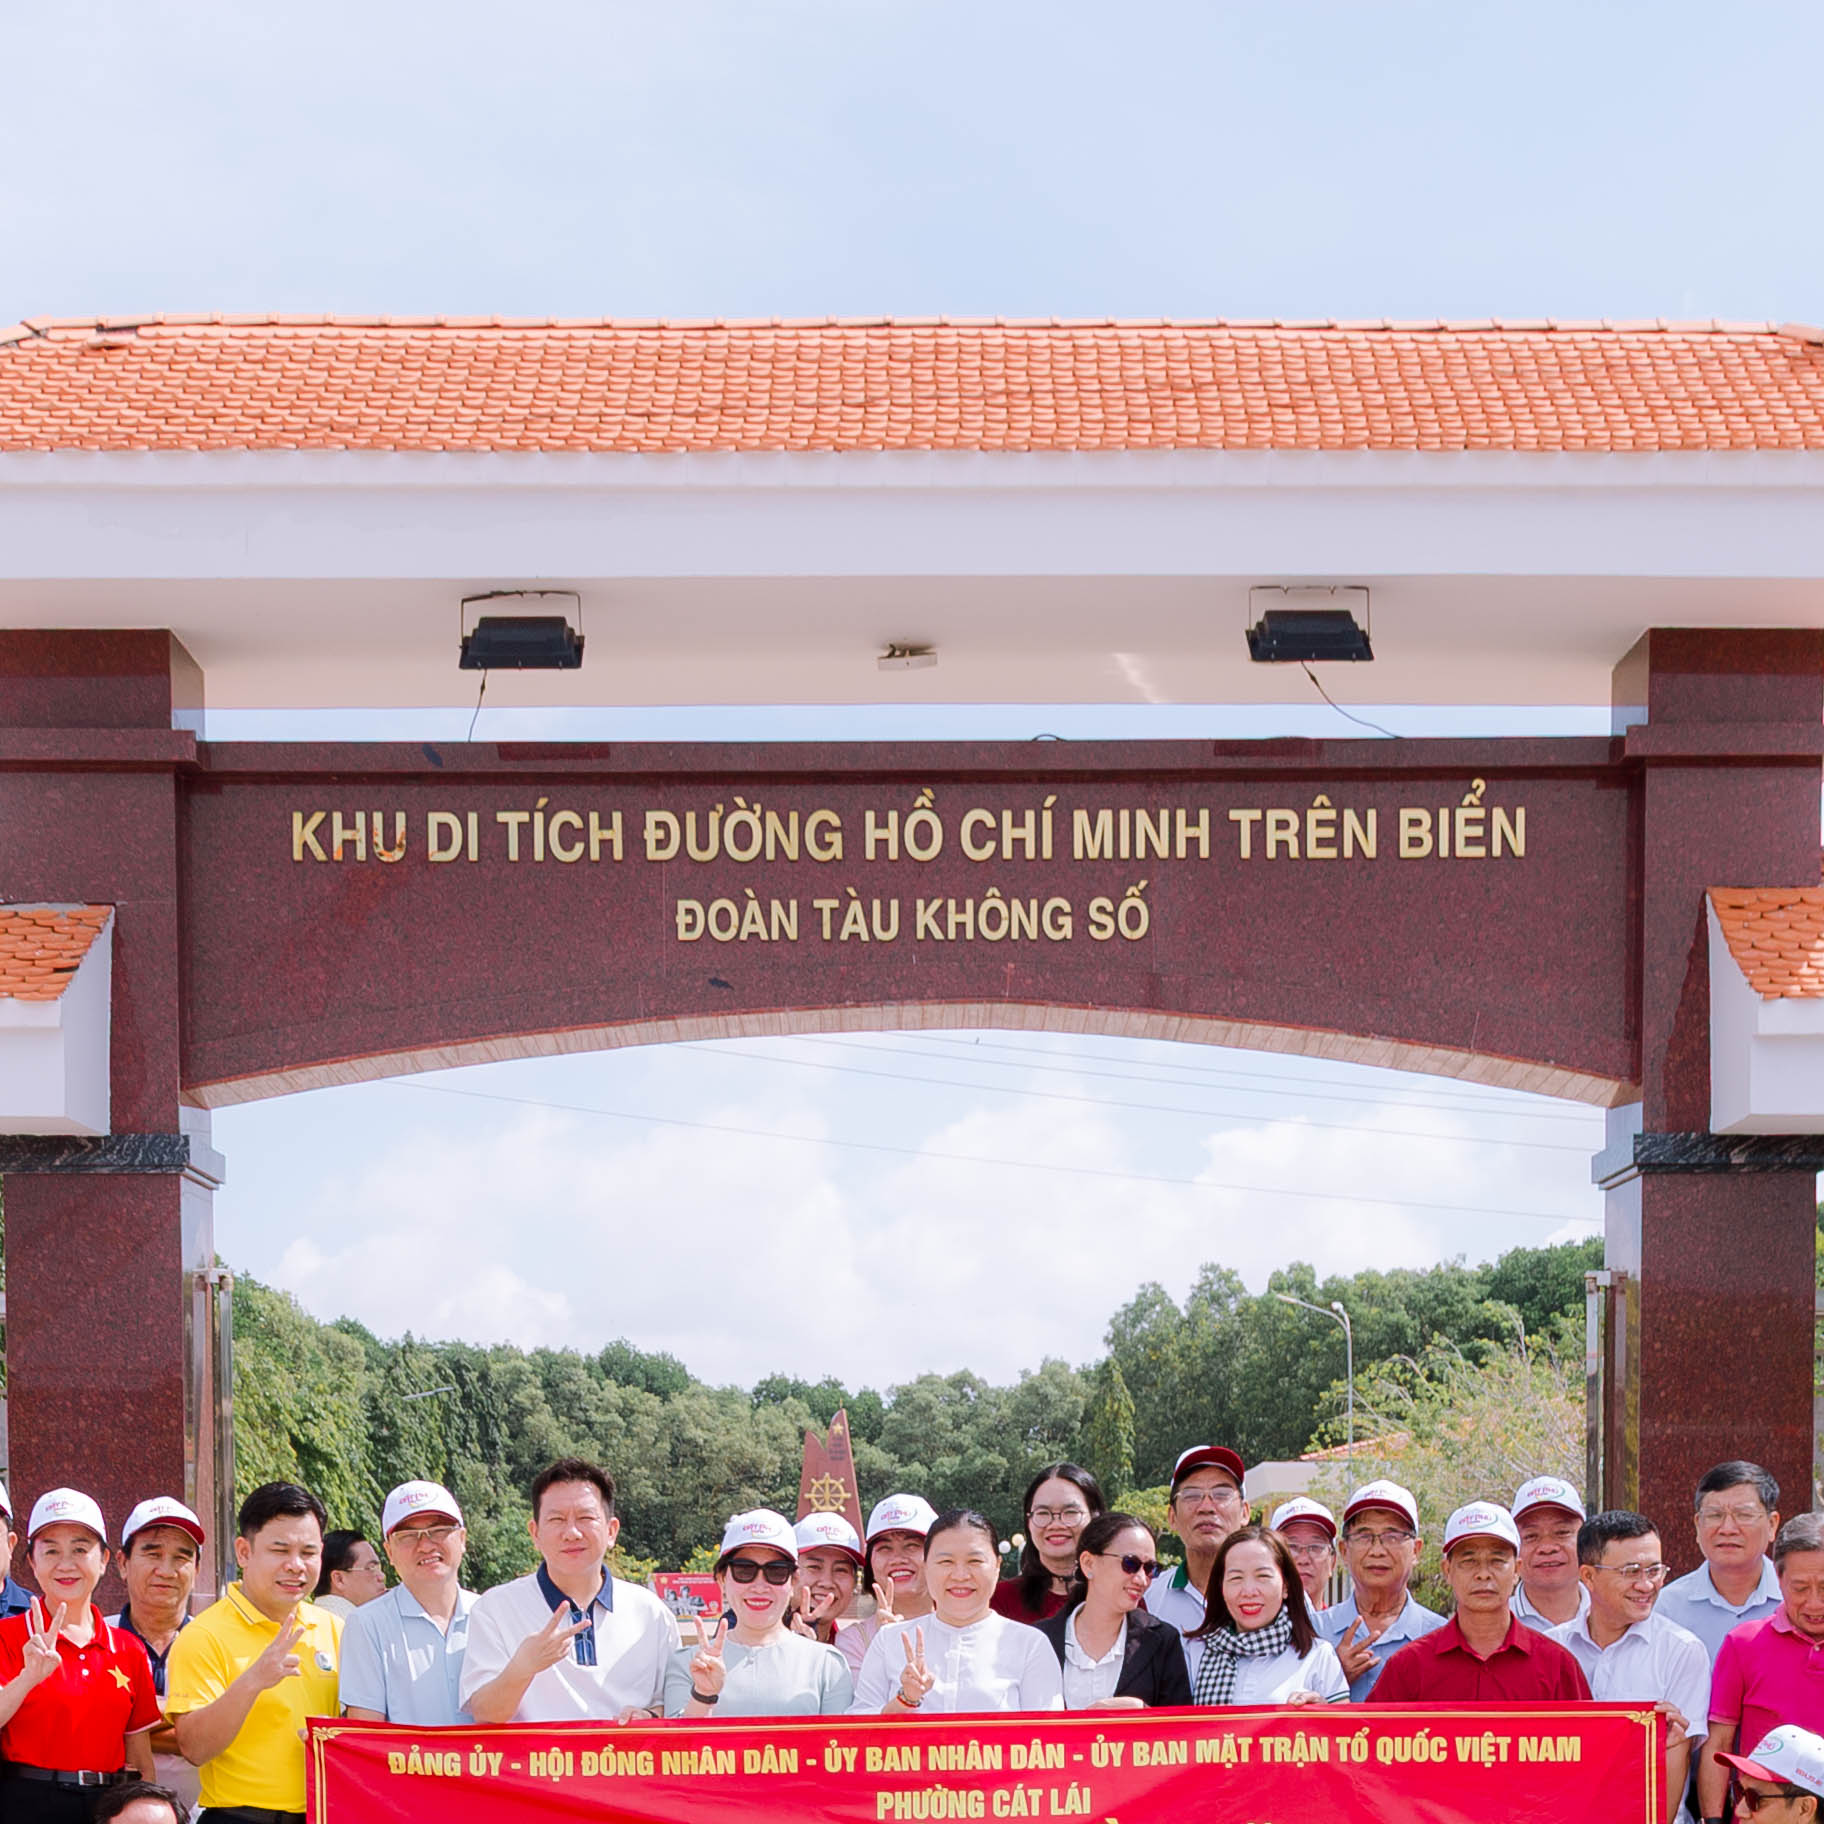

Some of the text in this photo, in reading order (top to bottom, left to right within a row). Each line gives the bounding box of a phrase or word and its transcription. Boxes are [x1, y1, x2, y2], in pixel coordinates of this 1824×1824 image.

[292, 778, 1528, 864] KHU DI TÍCH ĐƯỜNG HỒ CHÍ MINH TRÊN BIỂN
[675, 879, 1151, 944] ĐOÀN TÀU KHÔNG SỐ
[387, 1743, 462, 1778] ĐẢNG
[468, 1743, 504, 1778] ỦY
[529, 1745, 574, 1783] HỘI
[580, 1742, 655, 1778] ĐỒNG
[661, 1744, 736, 1777] NHÂN
[743, 1743, 799, 1776] DÂN
[824, 1738, 859, 1773] ỦY
[865, 1745, 921, 1773] BAN
[927, 1738, 1003, 1772] NHÂN
[1010, 1738, 1065, 1771] DÂN
[1090, 1733, 1125, 1769] ỦY
[1132, 1739, 1188, 1768] BAN
[1195, 1731, 1253, 1769] MẶT
[1258, 1730, 1330, 1769] TRẬN
[1335, 1726, 1370, 1764] TỔ
[1376, 1726, 1448, 1766] QUỐC
[1455, 1731, 1512, 1769] VIỆT
[1518, 1735, 1581, 1763] NAM
[876, 1780, 1092, 1821] PHƯỜNG CÁT LÁI
